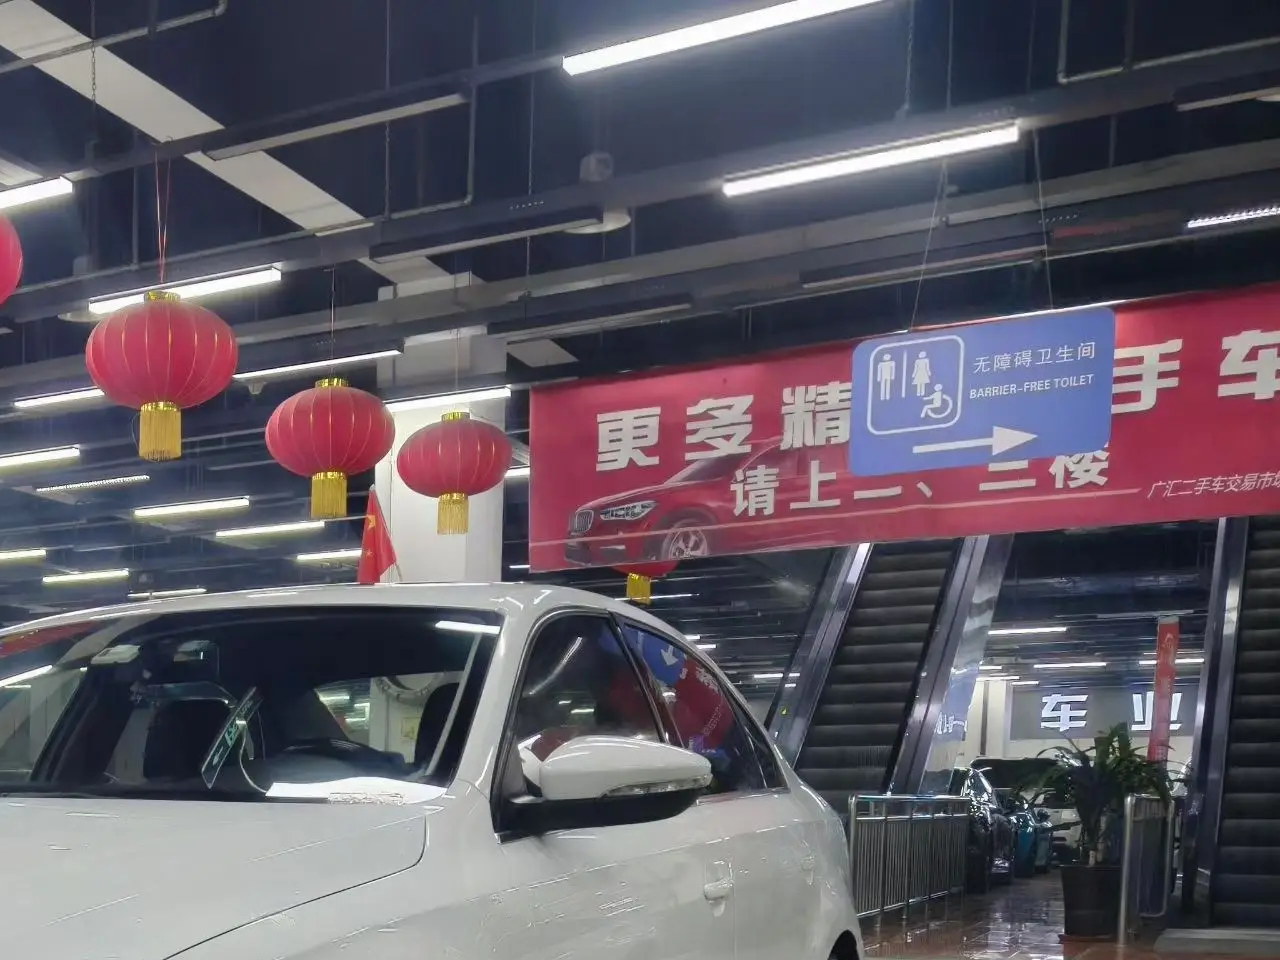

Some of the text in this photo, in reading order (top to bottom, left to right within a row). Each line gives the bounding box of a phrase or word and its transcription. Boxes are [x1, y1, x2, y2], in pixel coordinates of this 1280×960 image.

[972, 341, 1096, 374] 无障碍卫生间
[969, 373, 1095, 399] BARRIER-FREE TOILET
